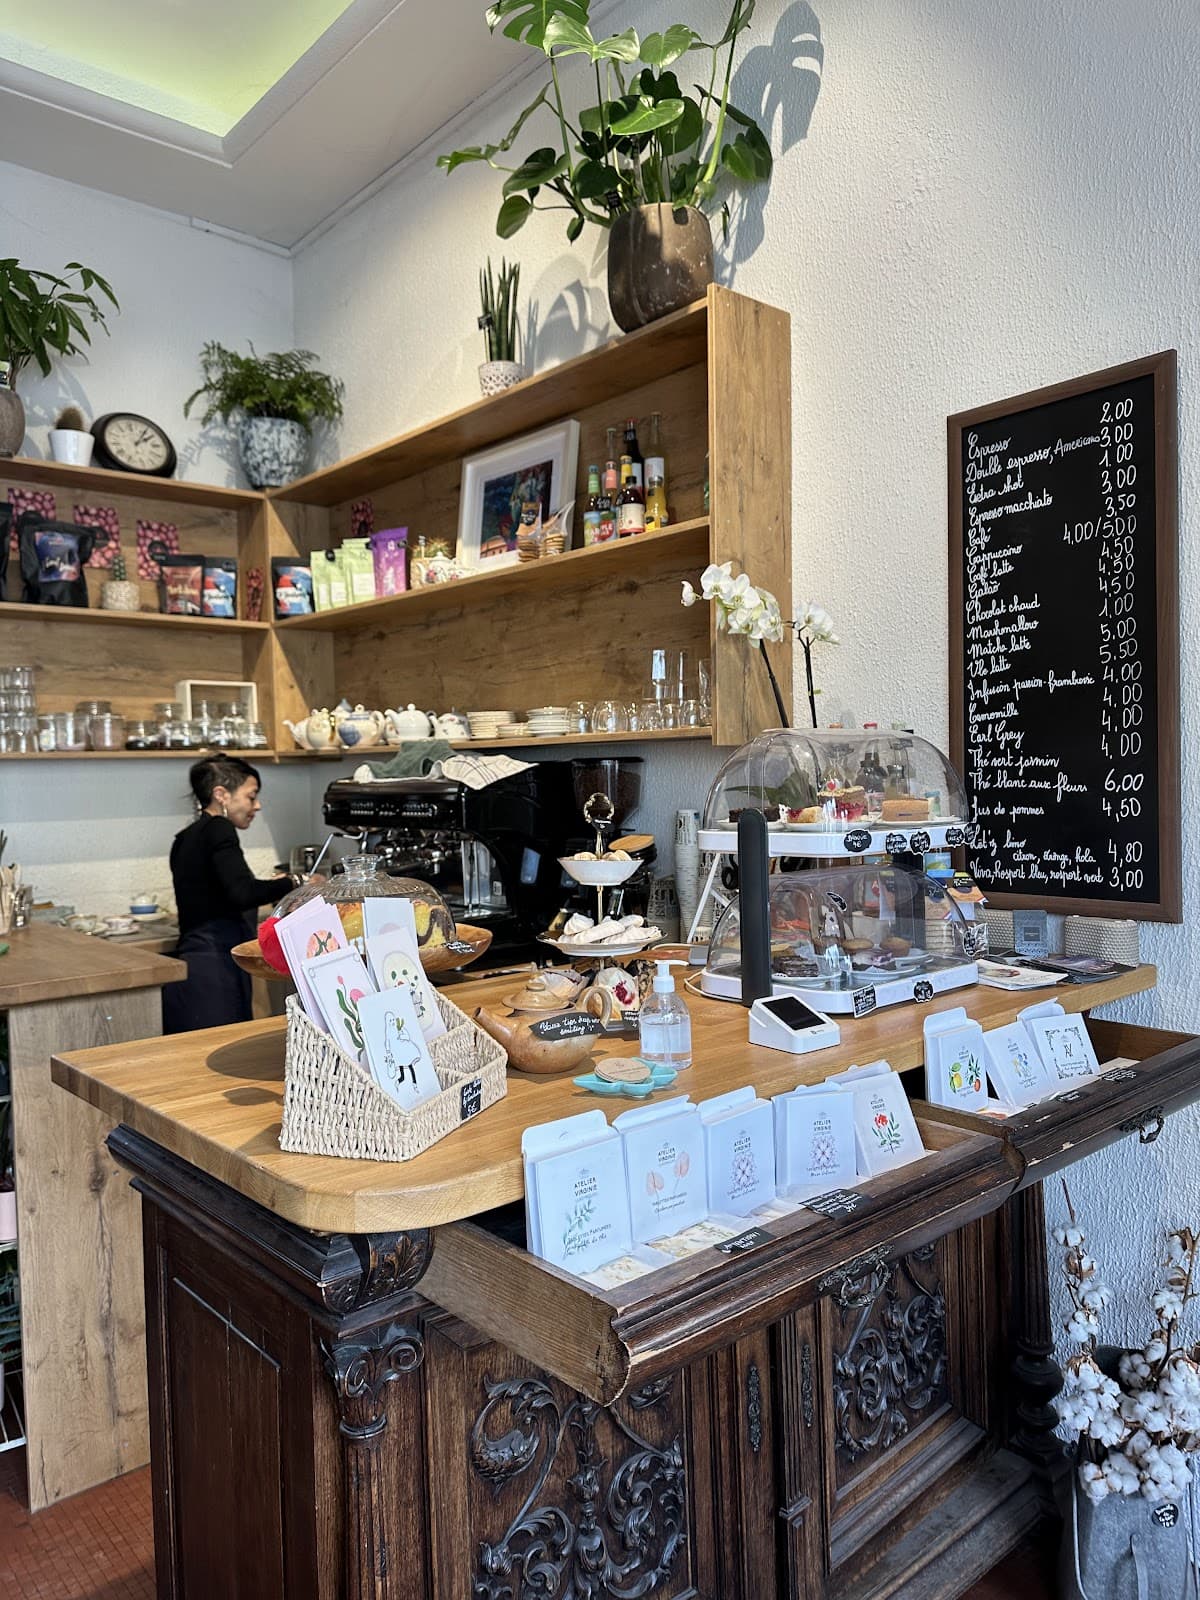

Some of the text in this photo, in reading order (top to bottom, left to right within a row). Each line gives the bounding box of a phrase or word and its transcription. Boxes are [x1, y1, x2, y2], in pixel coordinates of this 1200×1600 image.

[1100, 398, 1133, 423] 2.00
[965, 423, 1133, 483] Double espresso, Americano 3.00
[968, 432, 1012, 468] Espresso
[966, 443, 1133, 504] Extra shot 1.00
[968, 506, 1004, 532] Espresso
[1003, 488, 1053, 514] macchiato
[968, 526, 992, 550] Café
[967, 564, 989, 586] Café
[990, 559, 1014, 578] latte
[966, 598, 1007, 624] Chocolat
[1008, 593, 1040, 613] chaud
[967, 614, 1039, 640] Marshmallow
[967, 636, 1007, 659] Matcha
[1008, 633, 1032, 654] latte
[990, 654, 1011, 675] latte
[967, 678, 1011, 705] Infusion
[968, 702, 1020, 724] Camomille
[968, 723, 993, 744] Earl
[995, 720, 1025, 749] Grey
[968, 744, 991, 768] Thé
[991, 747, 1014, 767] vert
[1014, 750, 1060, 776] jasmin
[968, 768, 1144, 803] Thé blanc aux fleurs 6,00
[970, 795, 1141, 824] Jus de pommes 4,50
[1003, 829, 1027, 849] limo
[1075, 846, 1097, 862] kola
[1108, 839, 1143, 867] 4,80
[1028, 862, 1049, 884] bleu,
[1049, 865, 1082, 889] rosport
[1084, 867, 1105, 883] vert
[1109, 866, 1143, 891] 3,00
[658, 1147, 675, 1156] ATELIER
[574, 1177, 596, 1189] ATELIER
[574, 1184, 597, 1197] VIRGINIE
